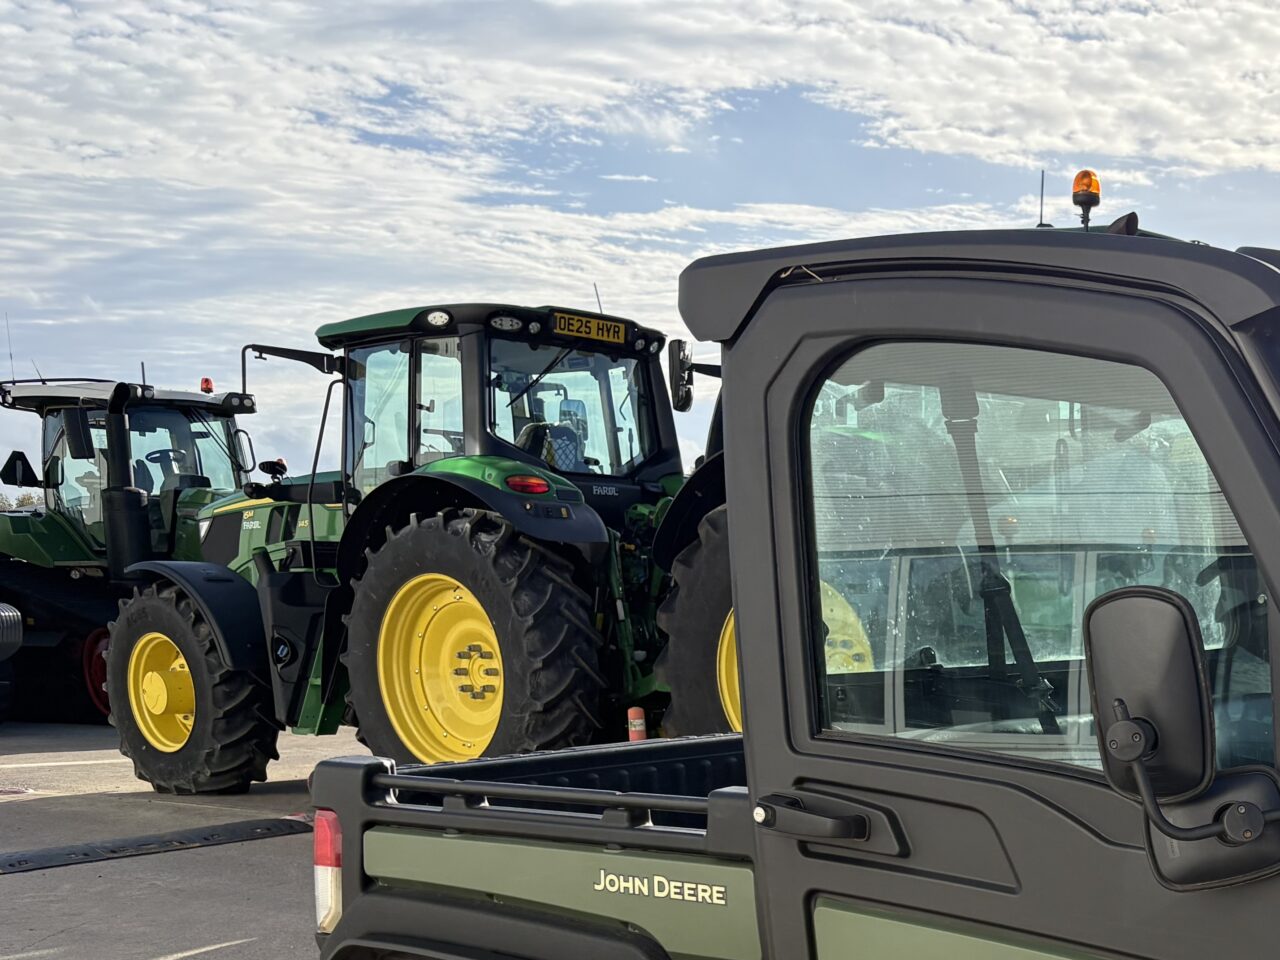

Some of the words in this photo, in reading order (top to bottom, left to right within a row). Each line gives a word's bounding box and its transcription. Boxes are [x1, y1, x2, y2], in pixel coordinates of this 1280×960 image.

[558, 316, 592, 335] OE25
[596, 322, 620, 340] HYR
[593, 869, 649, 897] JOHN
[653, 874, 727, 905] DEERE
